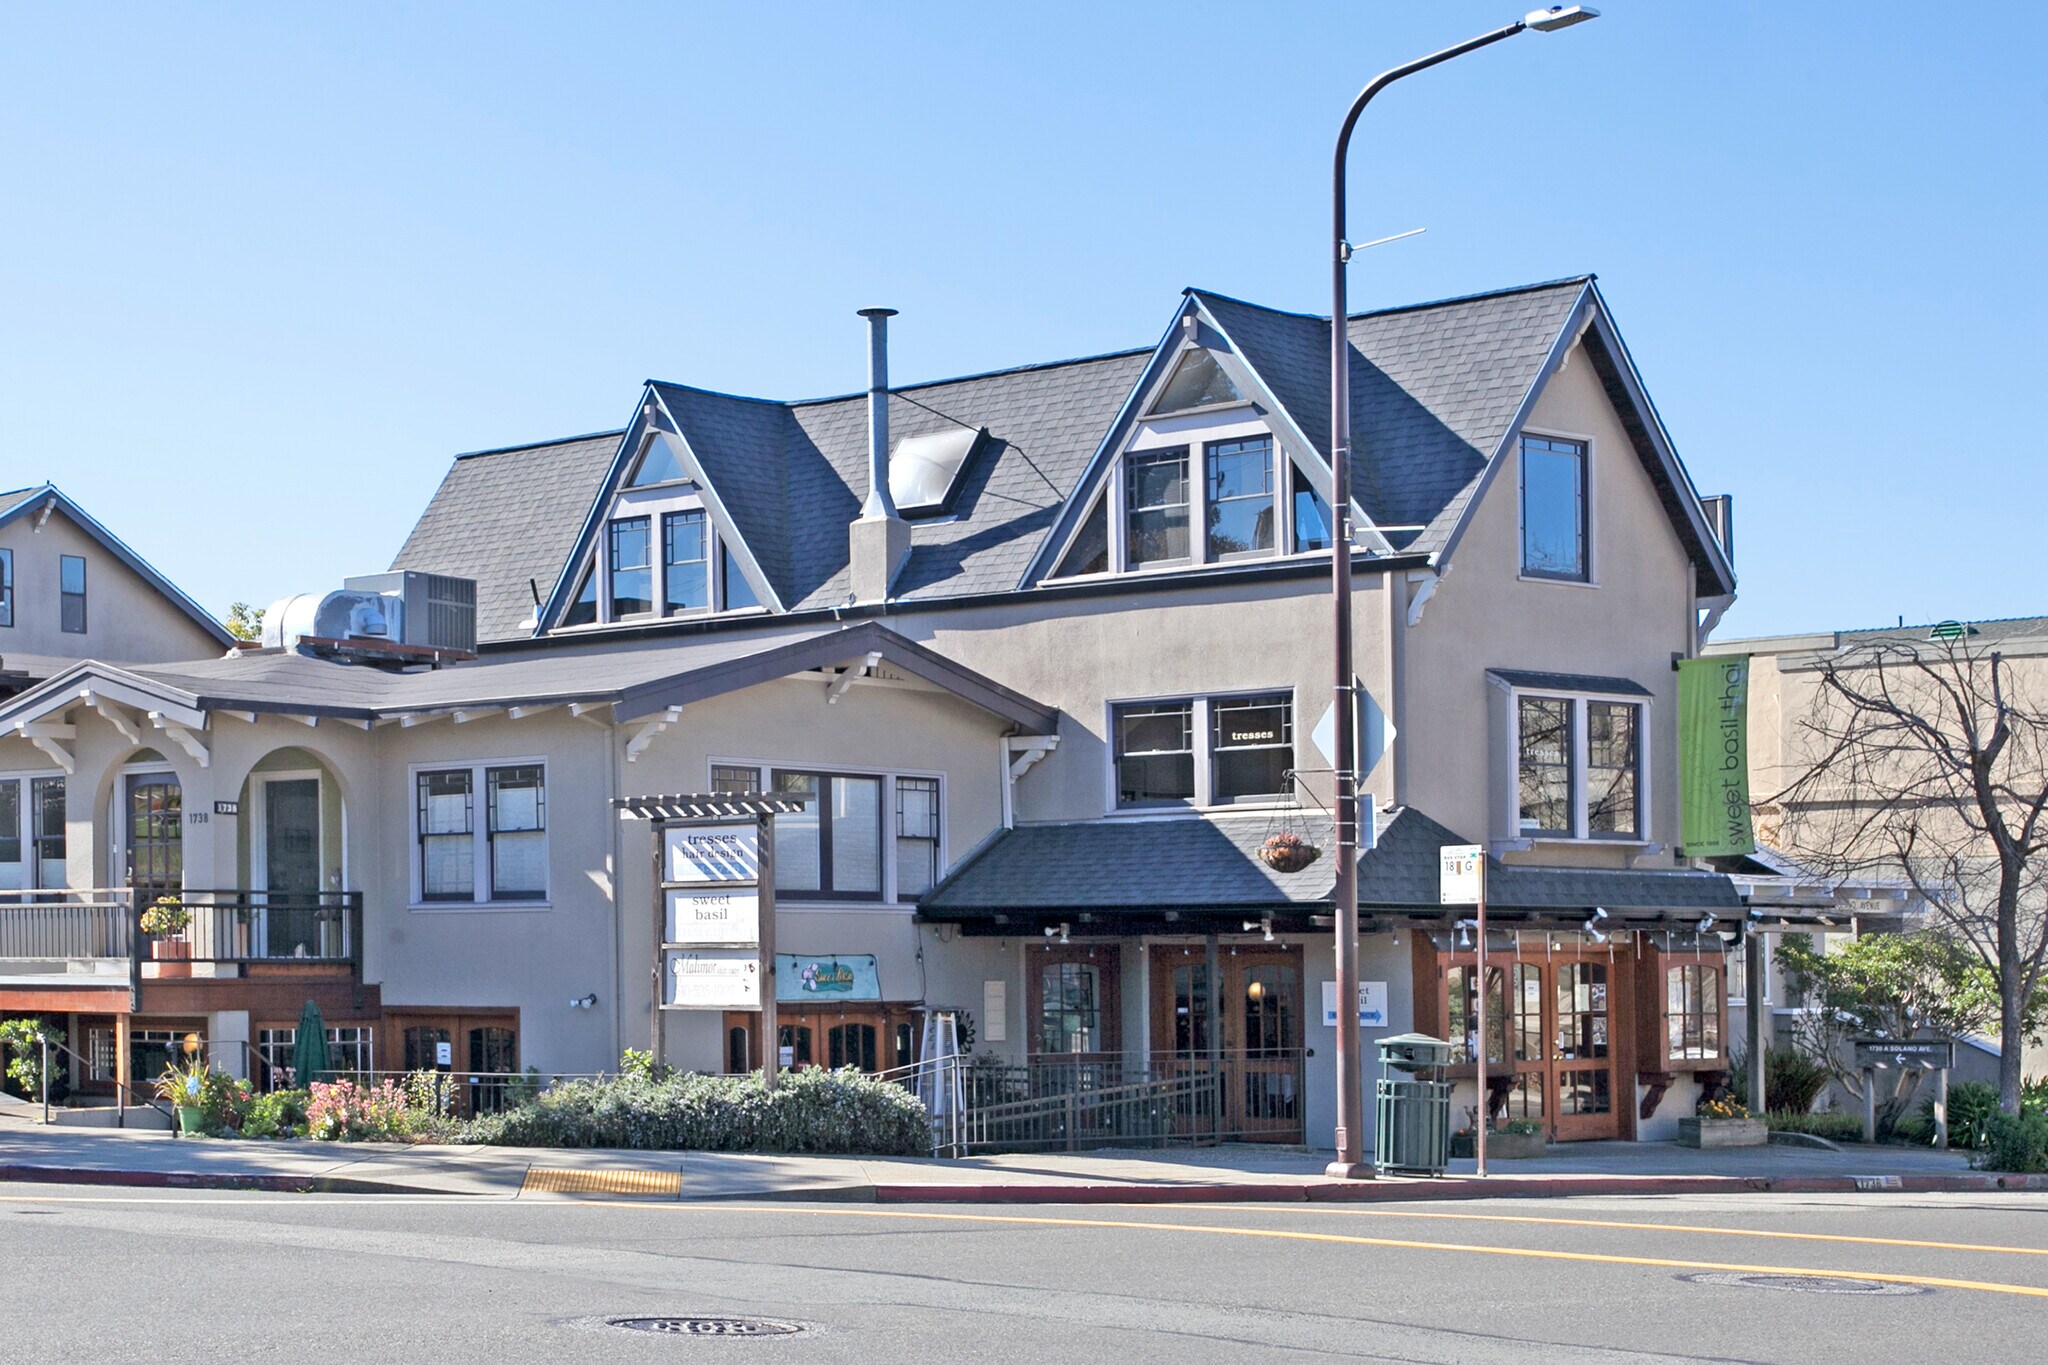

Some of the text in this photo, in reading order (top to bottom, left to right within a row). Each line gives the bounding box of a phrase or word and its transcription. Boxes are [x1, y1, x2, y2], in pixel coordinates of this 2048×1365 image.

[1232, 731, 1274, 740] tresses
[1718, 663, 1745, 846] sweet basil thai
[189, 812, 209, 824] 1738
[688, 834, 737, 845] tresses
[682, 846, 743, 860] hair design
[1445, 861, 1472, 871] 18 G
[692, 894, 731, 906] sweet
[695, 908, 728, 921] basil
[1890, 1045, 1917, 1053] SOLANO
[1918, 1045, 1933, 1053] AVE.
